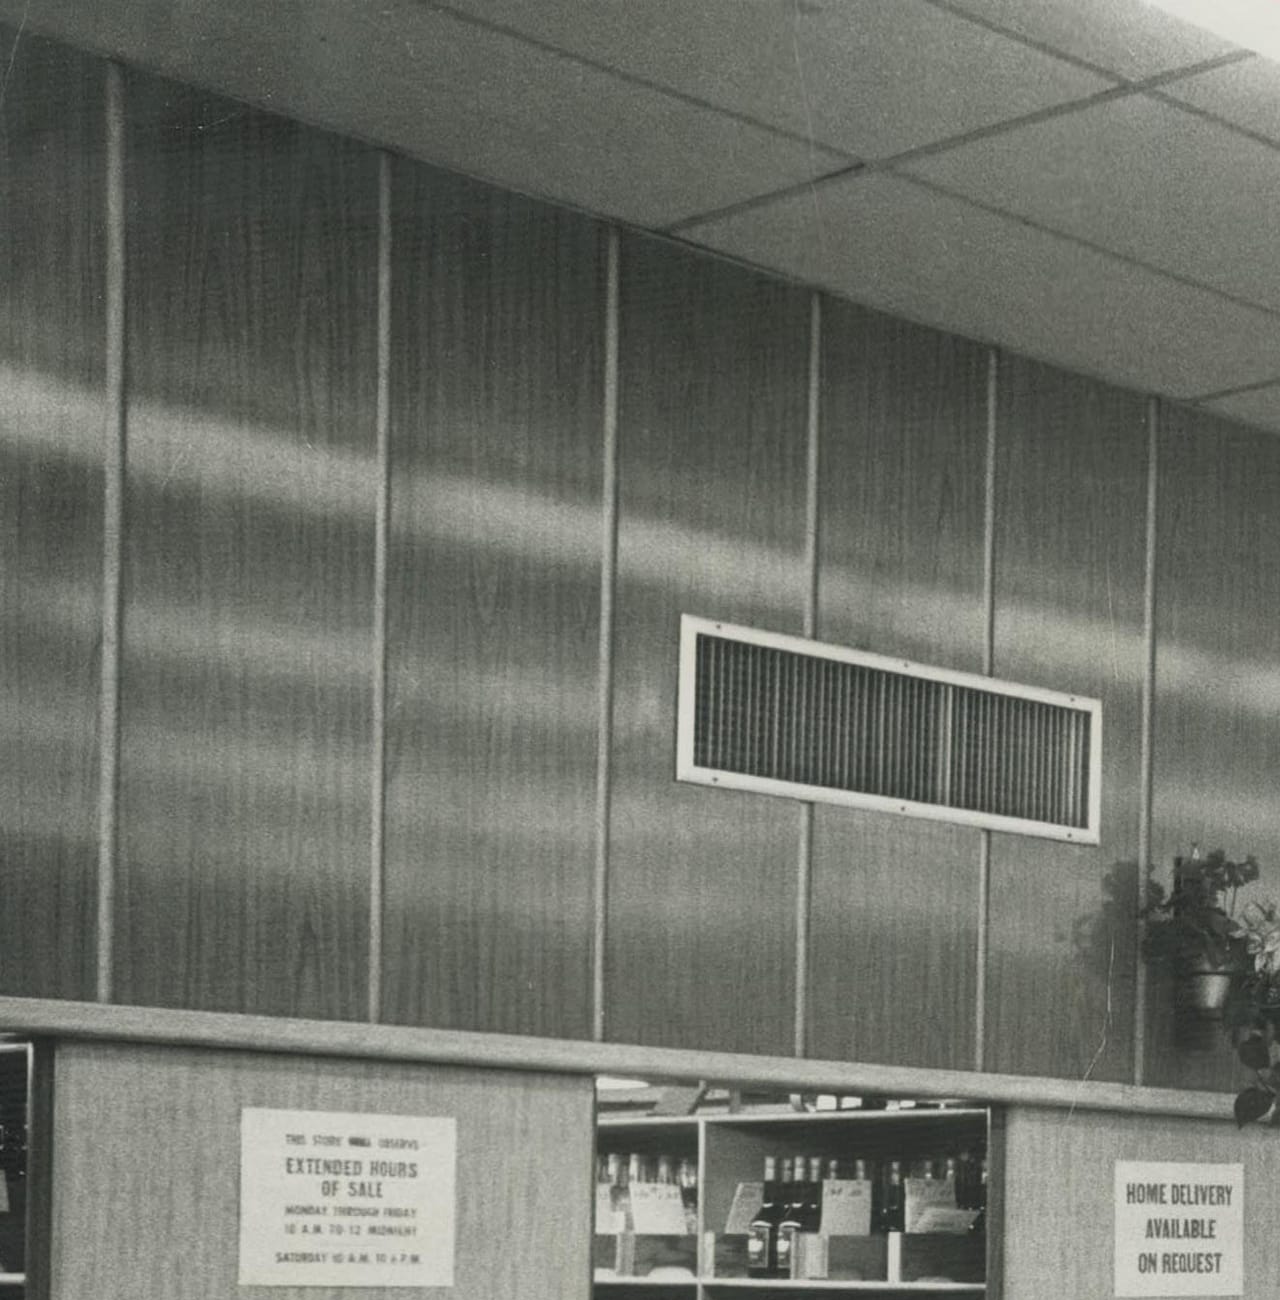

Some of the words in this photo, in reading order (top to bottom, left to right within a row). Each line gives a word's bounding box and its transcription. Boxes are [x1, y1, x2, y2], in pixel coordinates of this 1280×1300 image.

[286, 1157, 363, 1176] EXTENDED
[369, 1160, 418, 1178] HOURS
[321, 1180, 339, 1197] OF
[347, 1181, 384, 1198] SALE
[1126, 1183, 1167, 1204] HOME
[1171, 1184, 1232, 1206] DELIVERY
[285, 1205, 327, 1216] MONDAY
[333, 1206, 379, 1216] THROUGH
[383, 1207, 417, 1218] FRIDAY
[329, 1224, 344, 1235] TO
[349, 1225, 361, 1235] 12
[368, 1225, 417, 1237] MIDNIGHT
[1145, 1218, 1216, 1239] AVAILABLE
[275, 1252, 327, 1263] SATURDAY
[1138, 1252, 1157, 1274] ON
[1162, 1252, 1222, 1274] REQUEST
